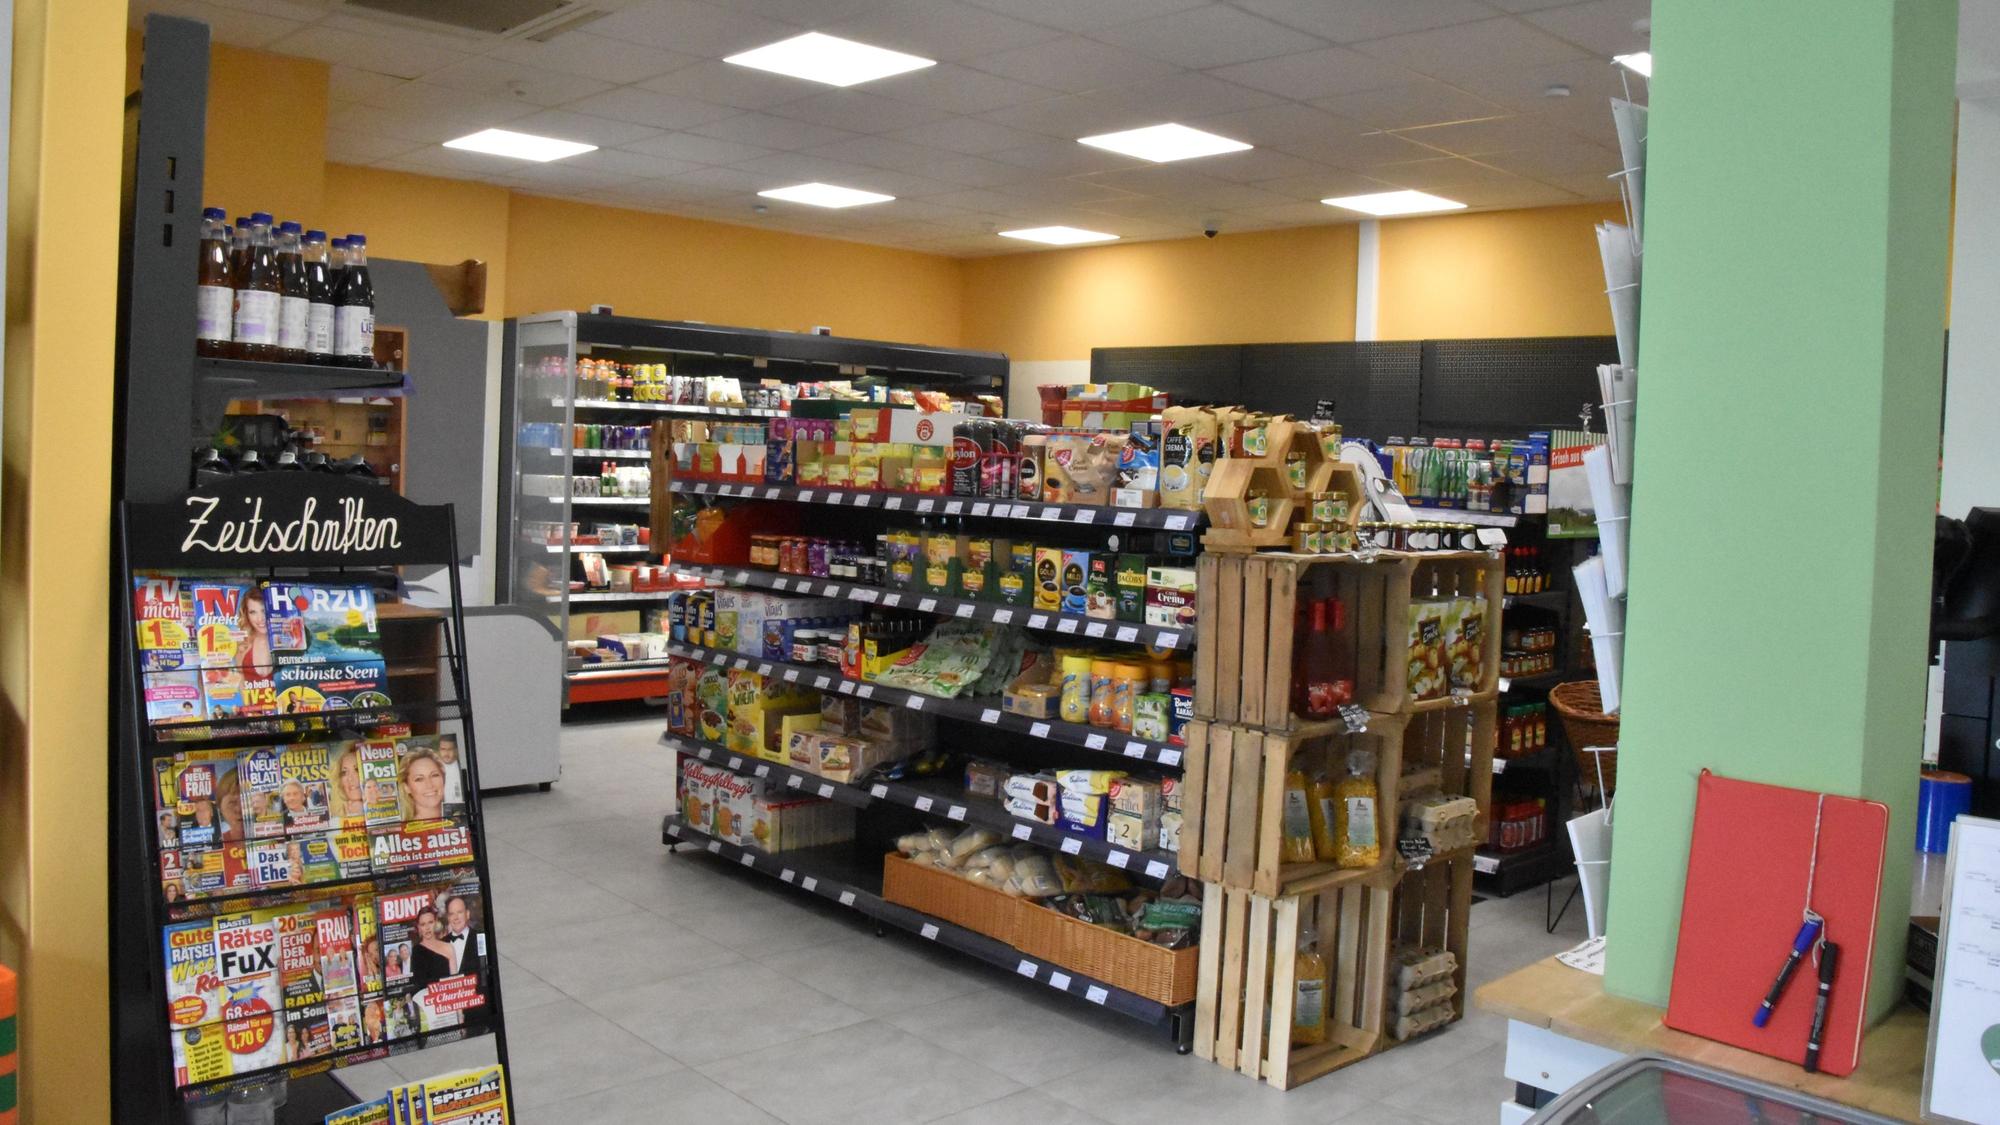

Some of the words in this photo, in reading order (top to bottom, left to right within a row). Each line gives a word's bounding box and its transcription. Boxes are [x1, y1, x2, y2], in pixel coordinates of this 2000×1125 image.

[1552, 451, 1569, 465] Frisch
[1570, 453, 1580, 463] aus
[181, 496, 402, 554] Zeitschriften
[1118, 574, 1142, 584] JACOBS
[1157, 592, 1185, 605] Crema
[143, 601, 180, 618] mich
[199, 612, 239, 625] direkt
[281, 666, 342, 681] schönste
[345, 665, 379, 679] Seen
[280, 748, 328, 768] FREIZEIT
[361, 745, 394, 761] Neue
[250, 759, 277, 772] NEUE
[282, 764, 330, 781] SPASS
[363, 761, 397, 780] Post
[185, 772, 211, 783] NEUE
[185, 781, 212, 797] FRAU
[1121, 824, 1130, 838] 2
[374, 834, 422, 856] Alles
[427, 826, 467, 849] aus!
[258, 851, 279, 863] Das
[375, 857, 388, 865] Ihr
[390, 853, 411, 864] Glück
[412, 852, 422, 860] ist
[424, 846, 469, 859] zerbrochen
[260, 863, 288, 881] Ehe
[383, 894, 430, 921] BUNTE
[278, 916, 297, 933] 20
[317, 915, 349, 944] FRAU
[171, 928, 213, 947] Gute
[282, 933, 312, 948] ECHO
[172, 942, 215, 963] RÄTSEL
[283, 946, 305, 959] DER
[283, 955, 313, 971] FRAU
[428, 978, 463, 993] Warum
[463, 976, 477, 985] tut
[286, 1010, 301, 1022] im
[436, 1003, 451, 1013] das
[229, 1030, 254, 1050] 1,70
[256, 1028, 265, 1043] €
[432, 1081, 499, 1105] SPEZIAL
